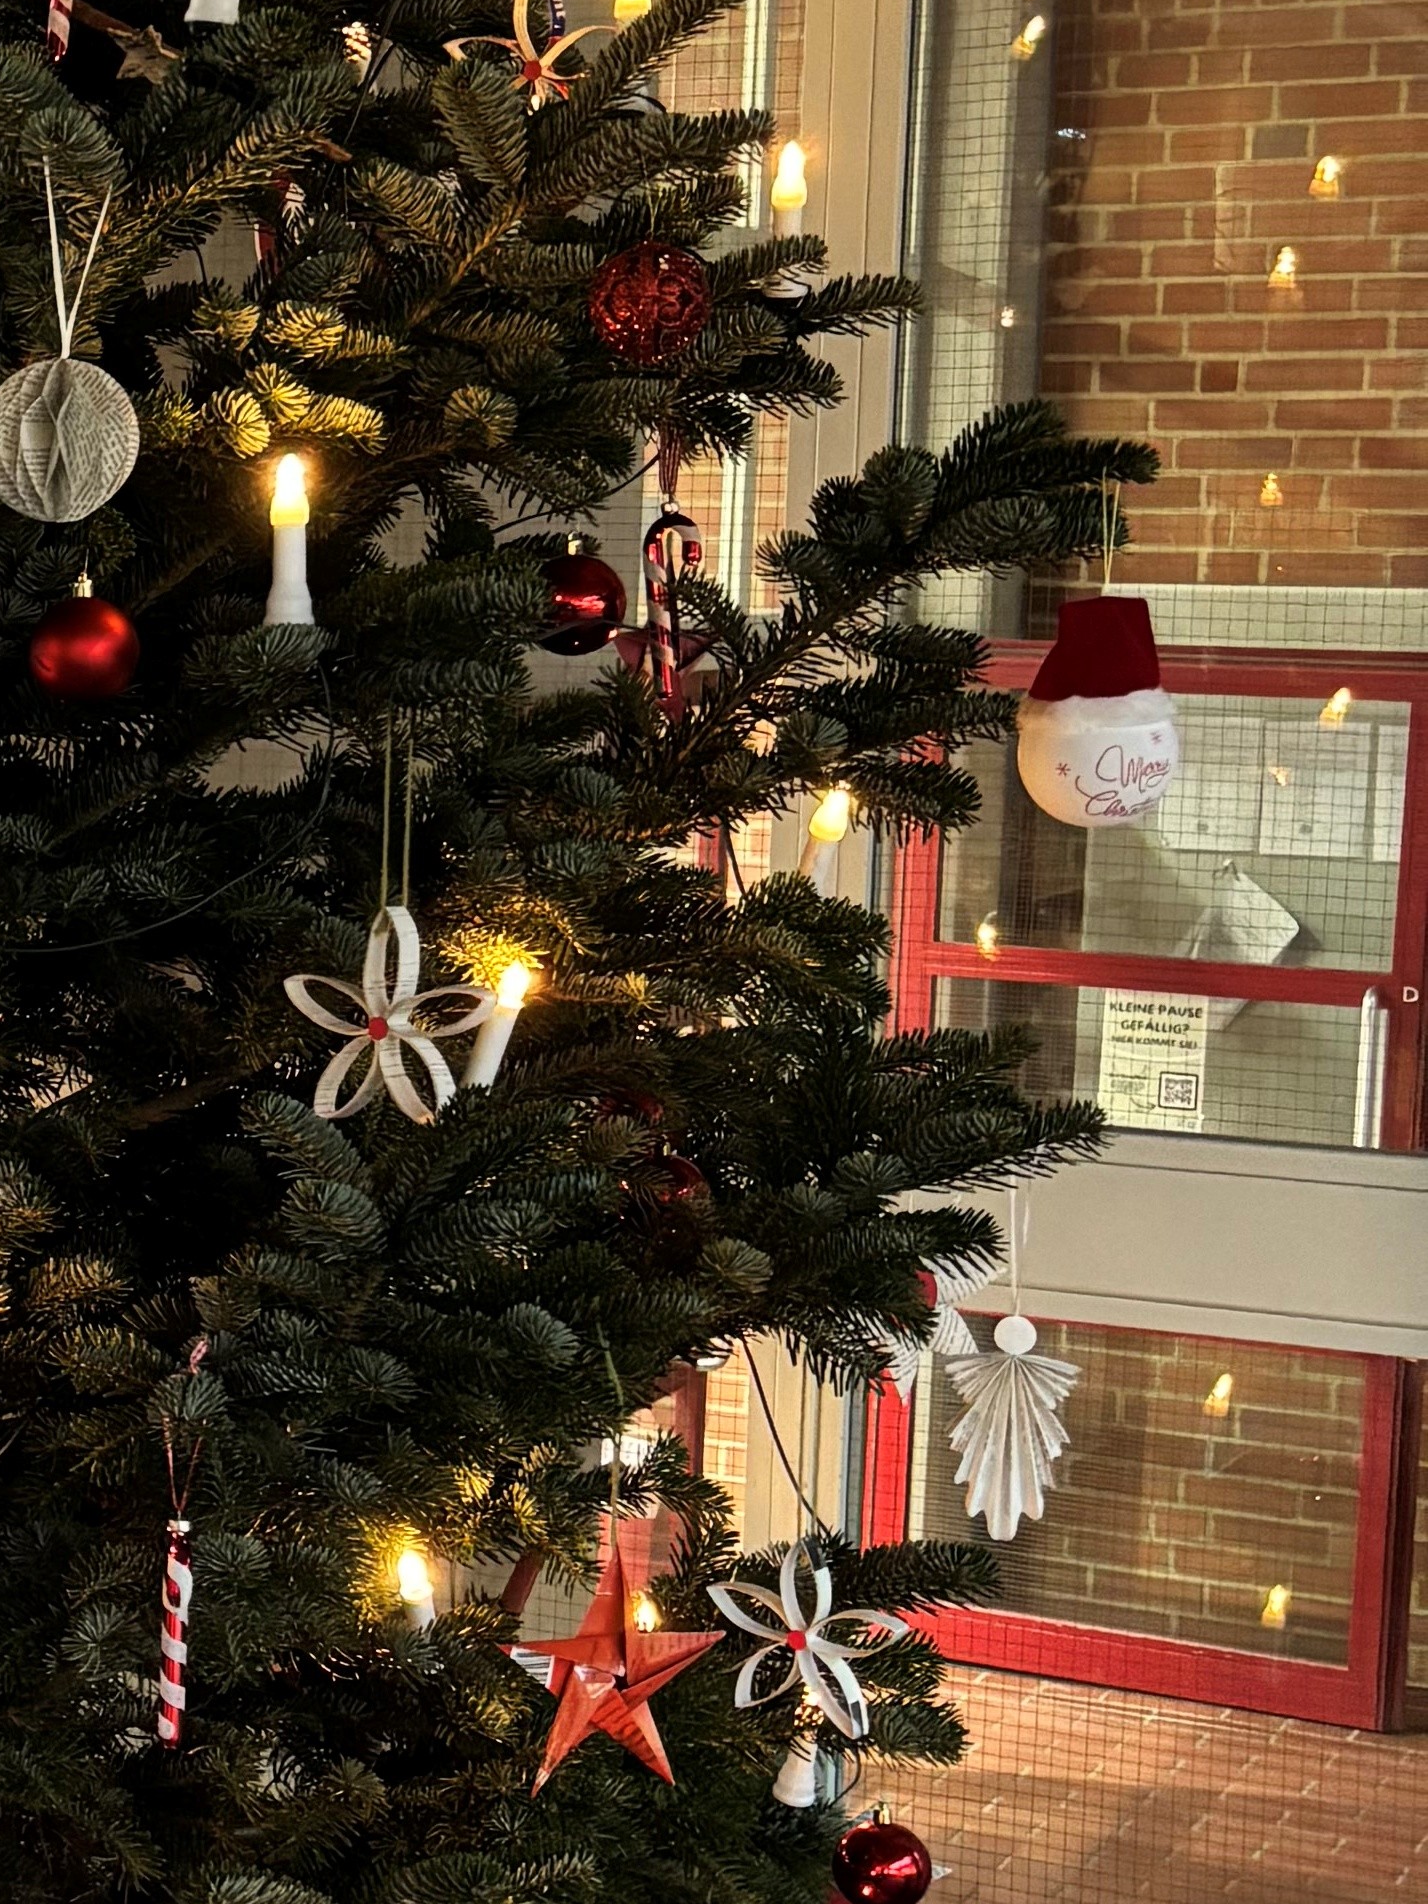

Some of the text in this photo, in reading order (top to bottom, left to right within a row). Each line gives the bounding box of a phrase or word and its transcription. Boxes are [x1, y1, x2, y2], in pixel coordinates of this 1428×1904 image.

[1402, 985, 1420, 1003] D
[1109, 1001, 1204, 1019] KLEINE PAUSE
